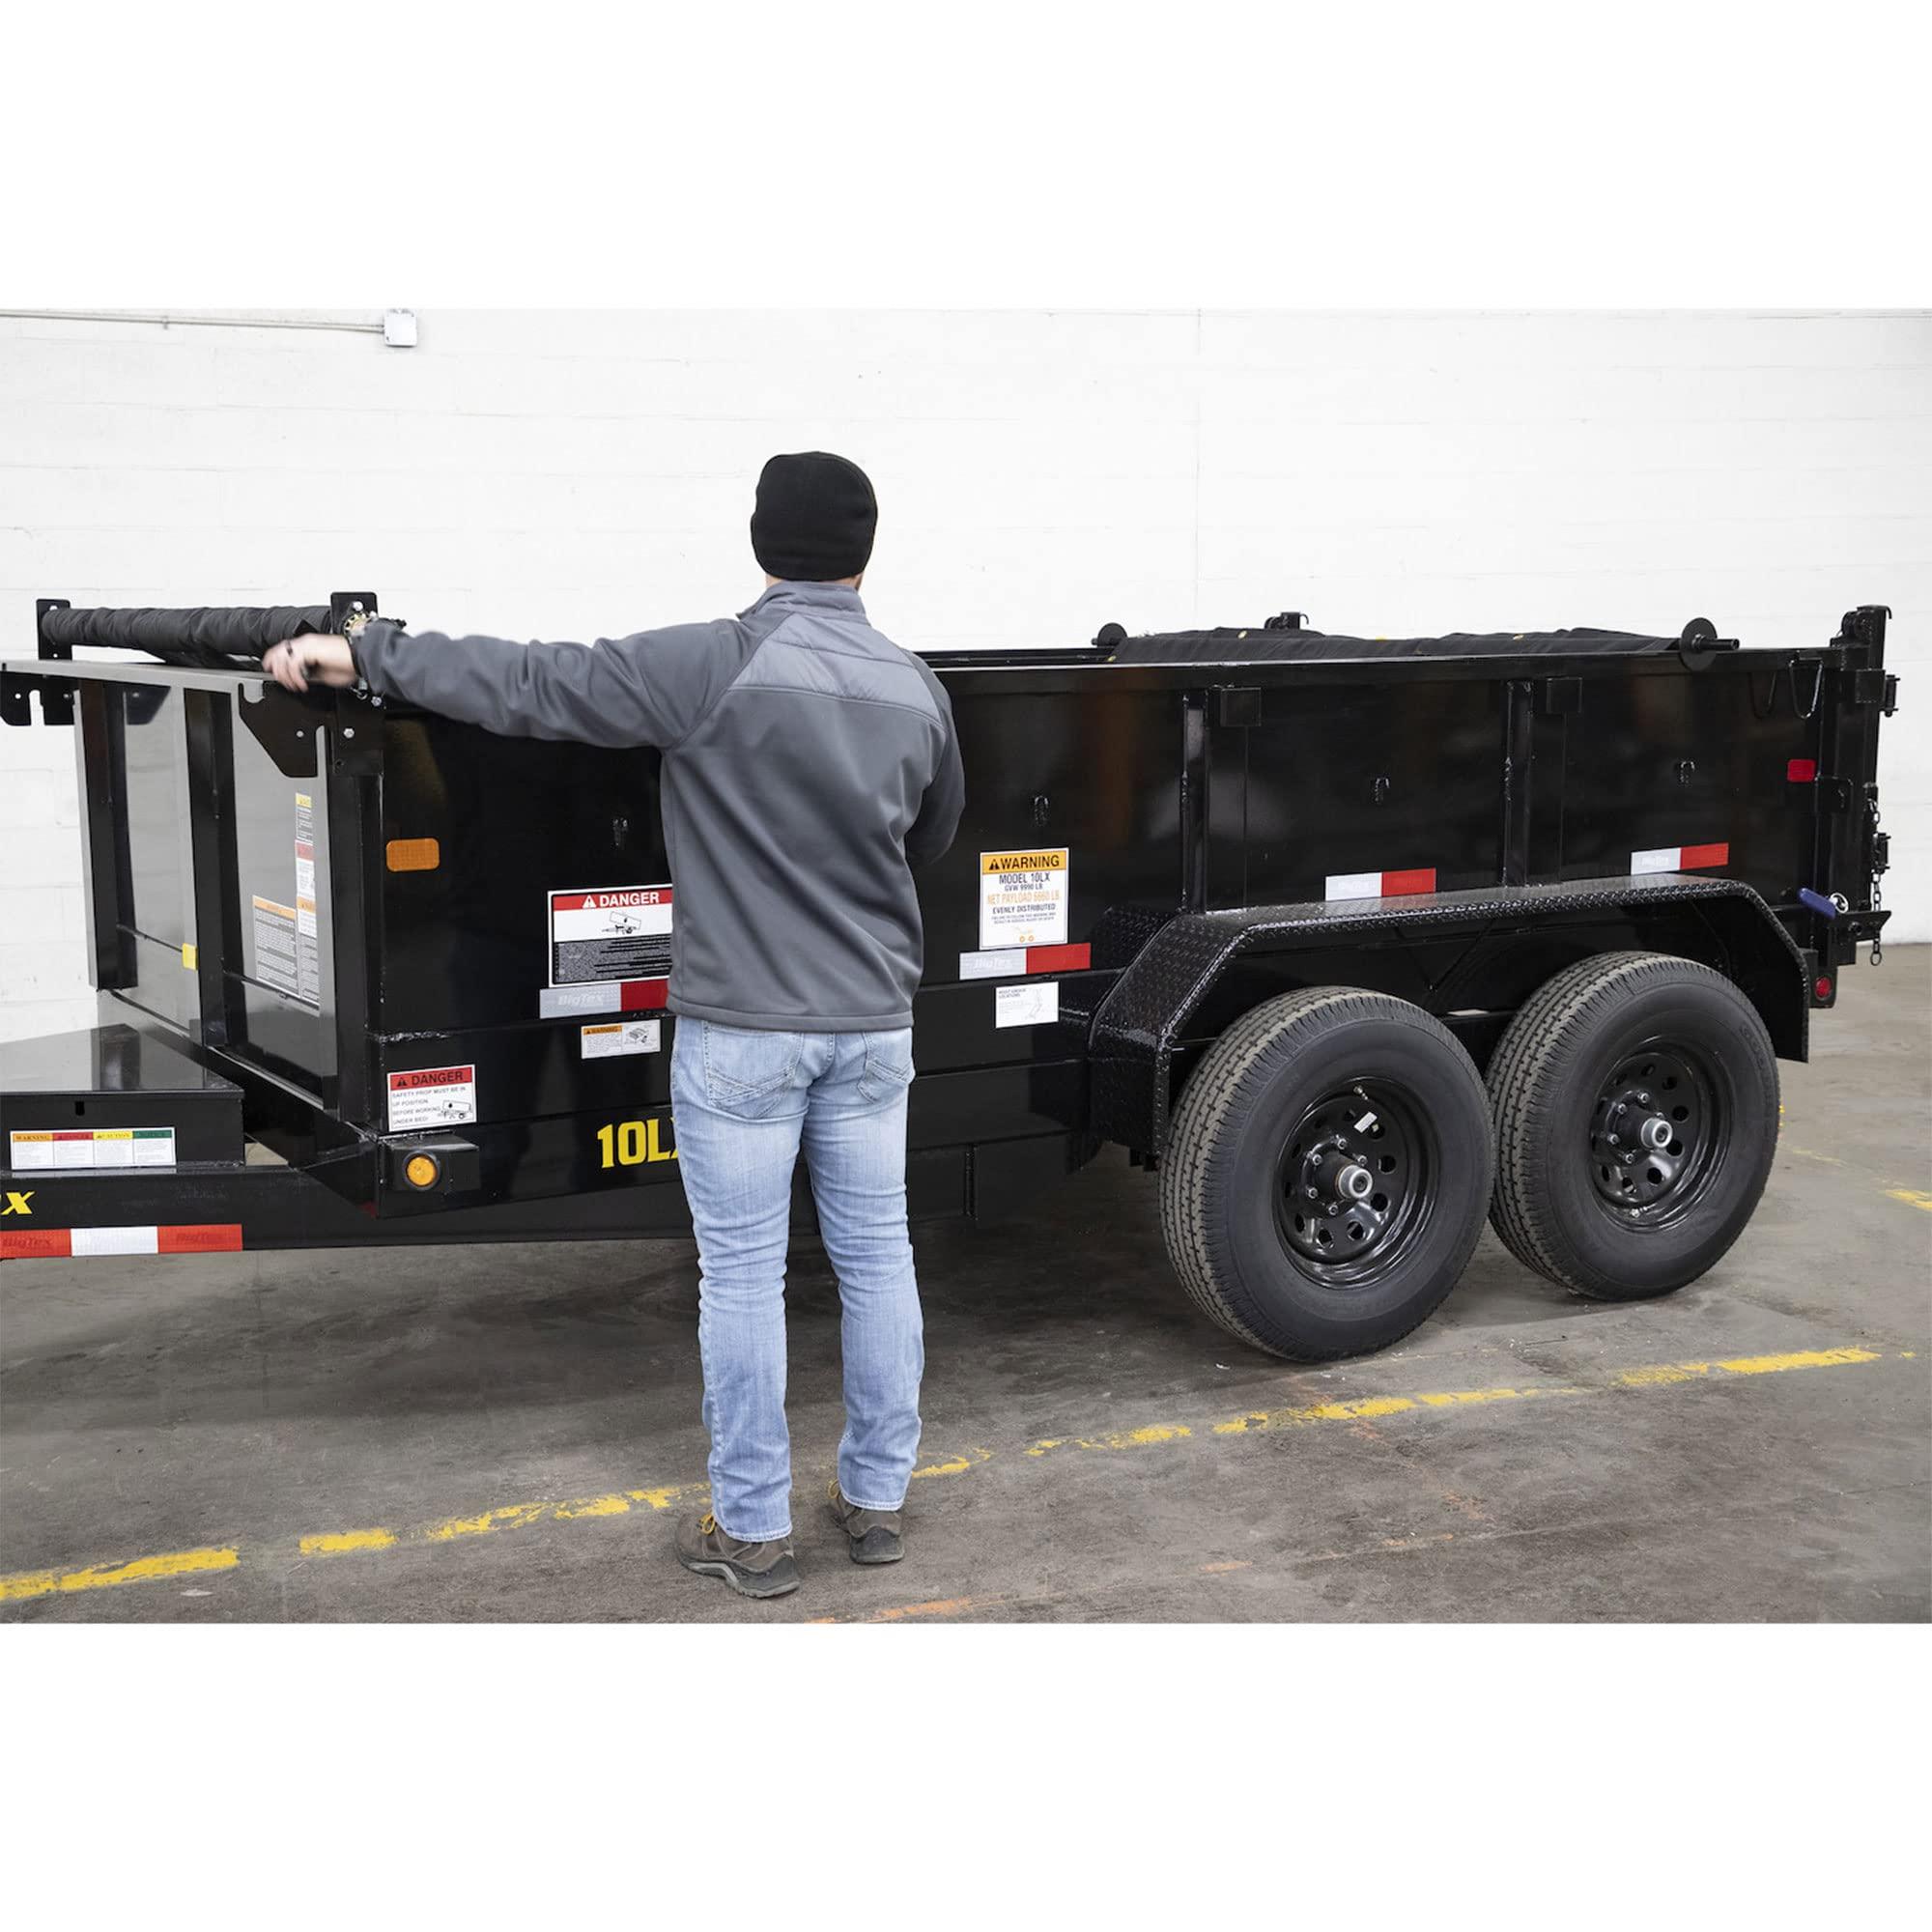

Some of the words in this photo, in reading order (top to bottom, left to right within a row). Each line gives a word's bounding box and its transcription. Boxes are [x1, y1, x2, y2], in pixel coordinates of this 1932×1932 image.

[1001, 855, 1060, 869] WARNING
[999, 873, 1027, 884] MODEL
[1031, 872, 1050, 883] 10LX
[600, 893, 659, 907] DANGER
[1002, 892, 1033, 903] PAYLOAD
[1017, 903, 1056, 913] DISTRIBUTED
[411, 1071, 463, 1086] DANGER
[597, 1118, 678, 1168] 10L
